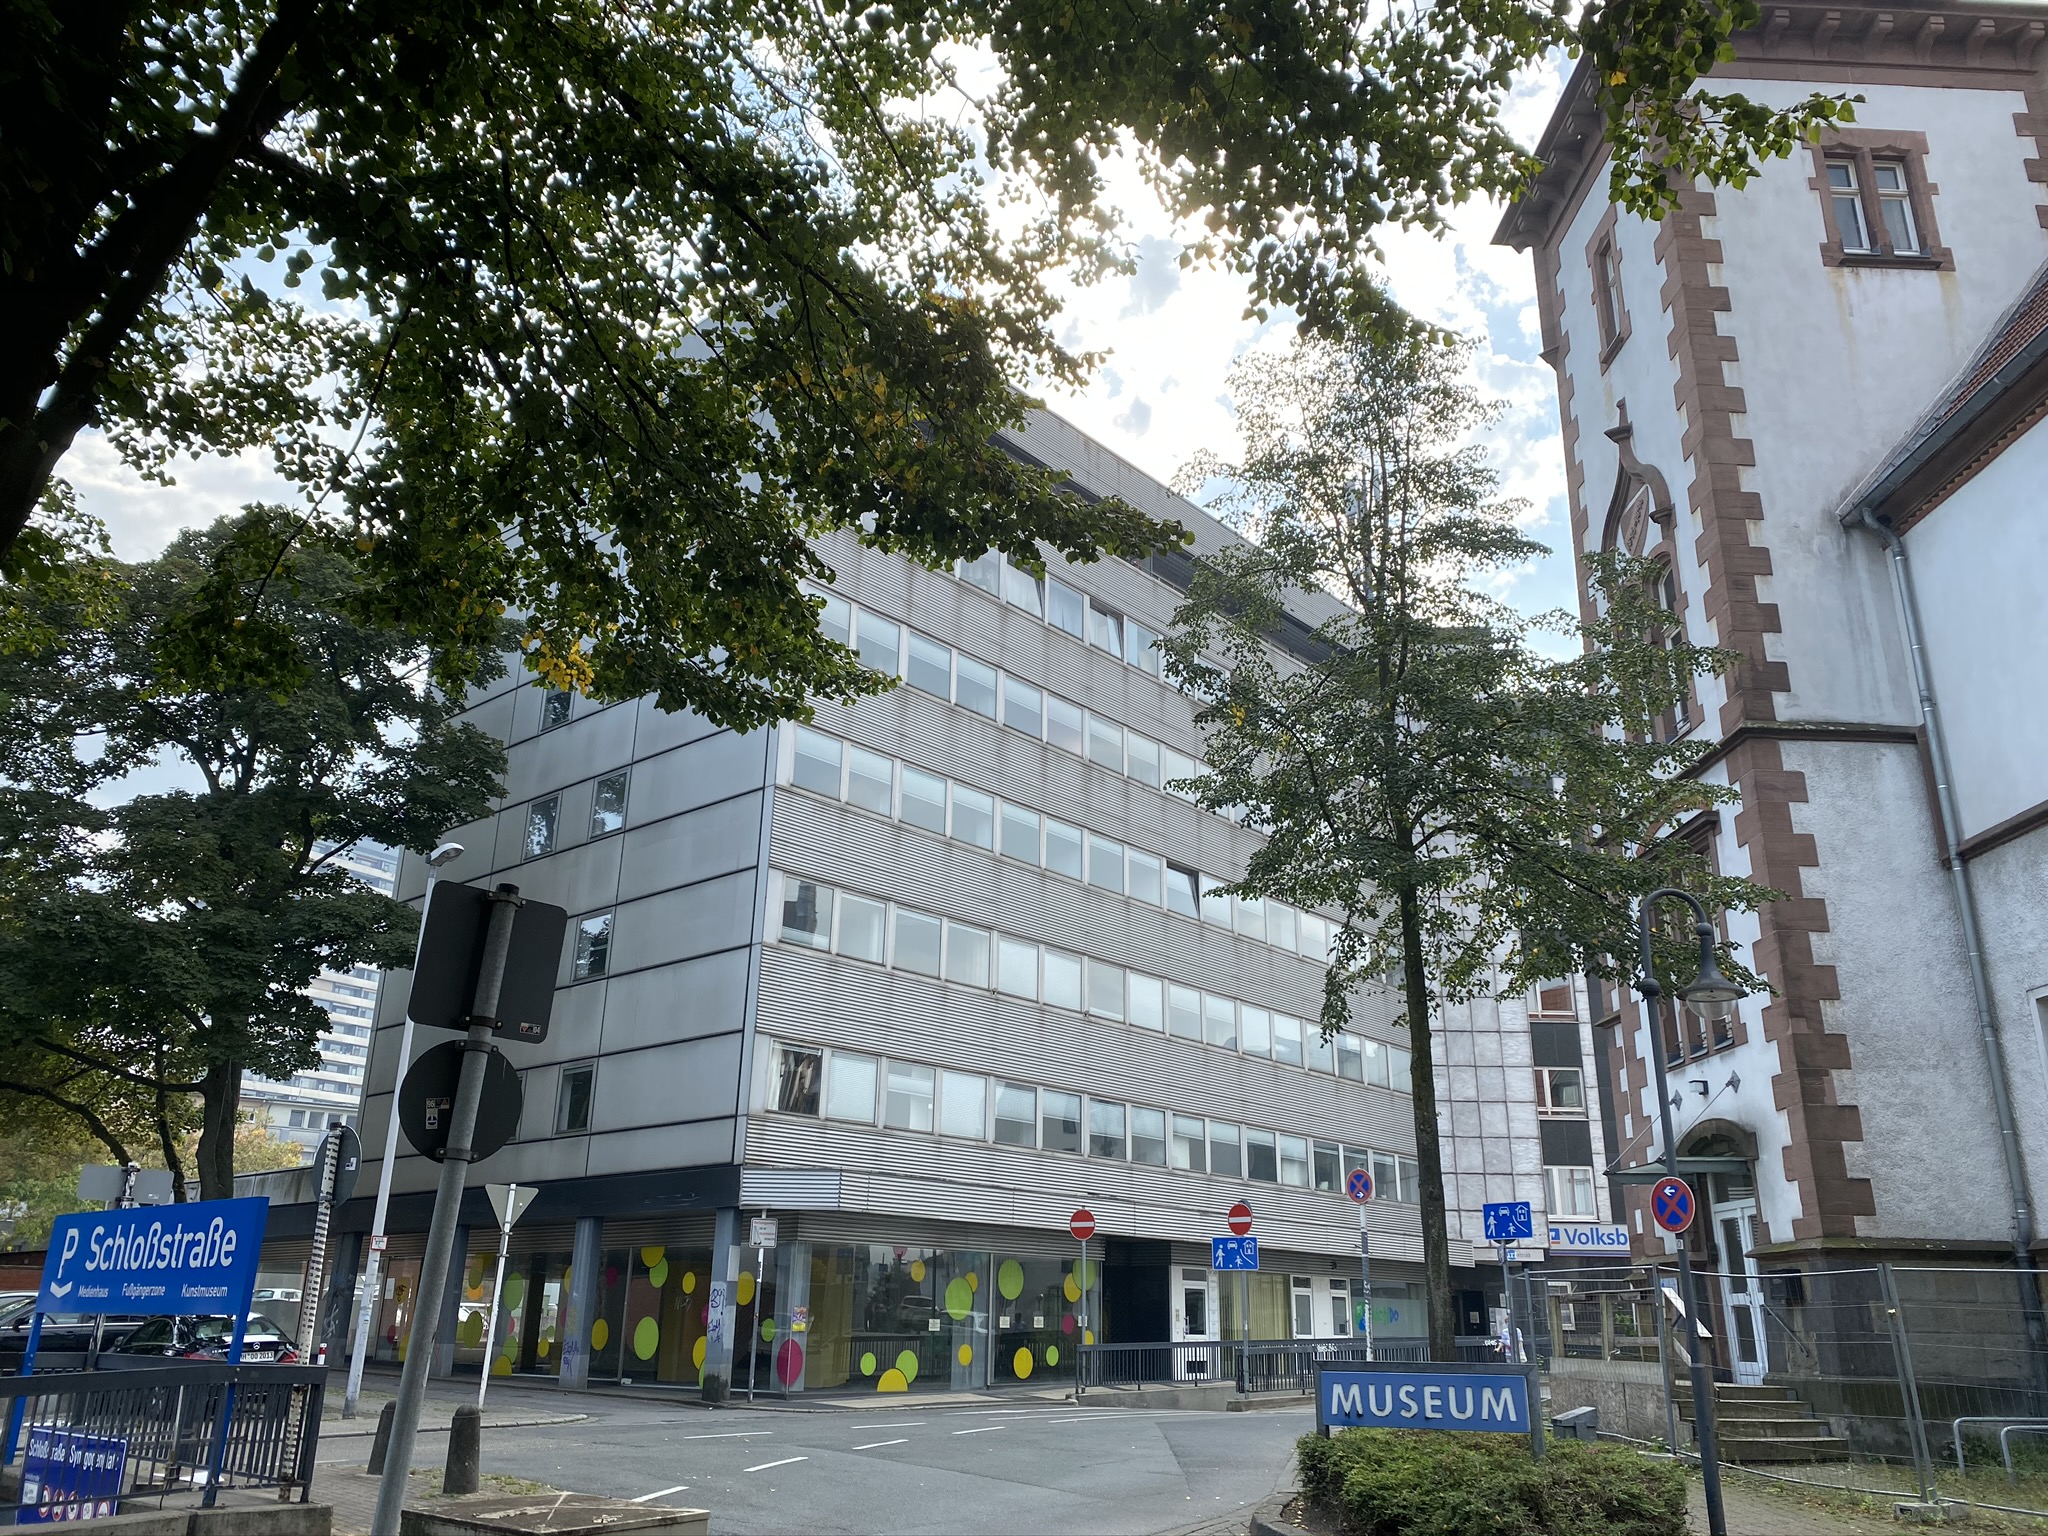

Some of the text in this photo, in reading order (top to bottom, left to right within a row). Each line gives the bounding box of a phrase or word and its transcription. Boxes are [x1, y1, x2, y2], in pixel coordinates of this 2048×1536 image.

[85, 1216, 237, 1271] Schloßstraße
[1564, 1227, 1628, 1245] Volksb
[78, 1283, 228, 1300] Medienhaus Fußgängerzone Kunstmuseum
[1331, 1383, 1517, 1422] MUSEUM
